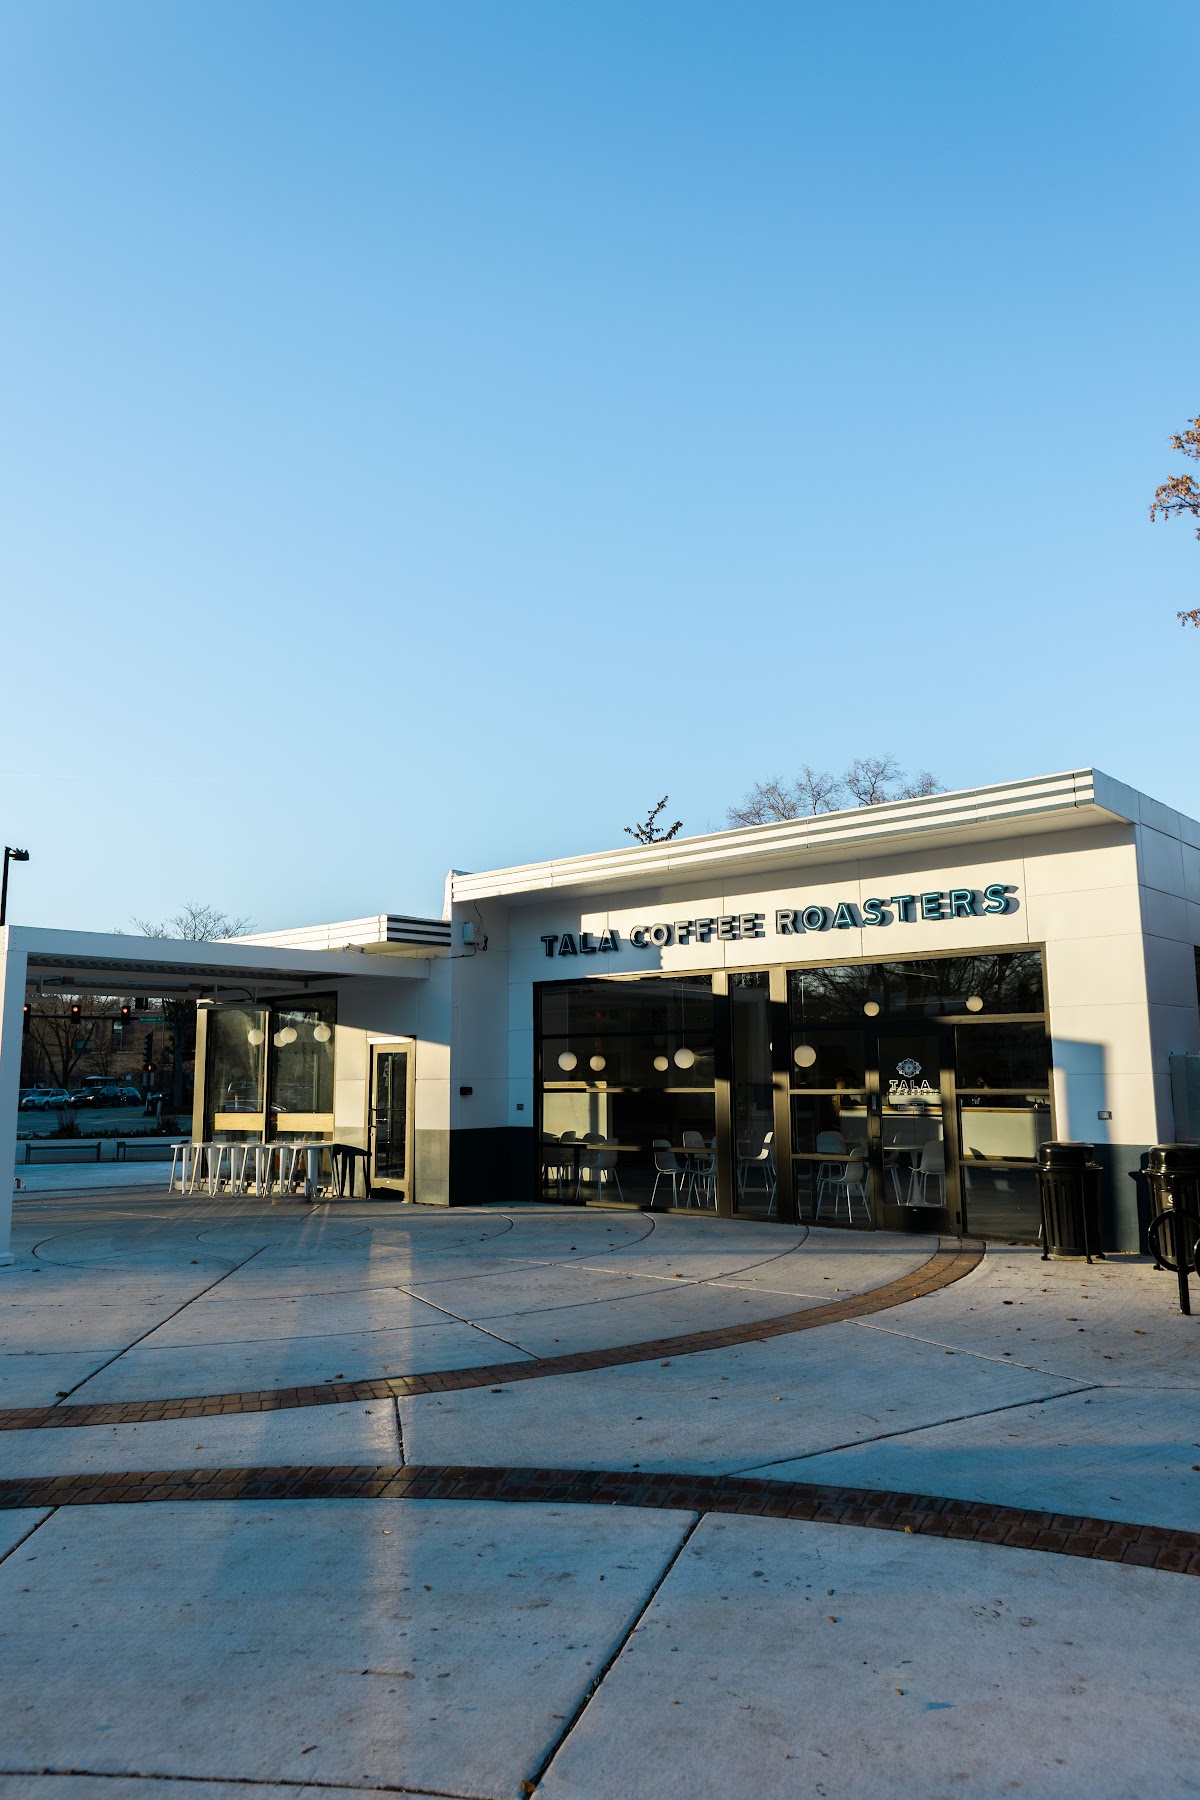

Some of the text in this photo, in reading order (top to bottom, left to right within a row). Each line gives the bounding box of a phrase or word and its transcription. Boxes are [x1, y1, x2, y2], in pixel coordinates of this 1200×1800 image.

[541, 883, 1016, 957] TALA COFFEE ROASTERS
[889, 1080, 930, 1090] TALA
